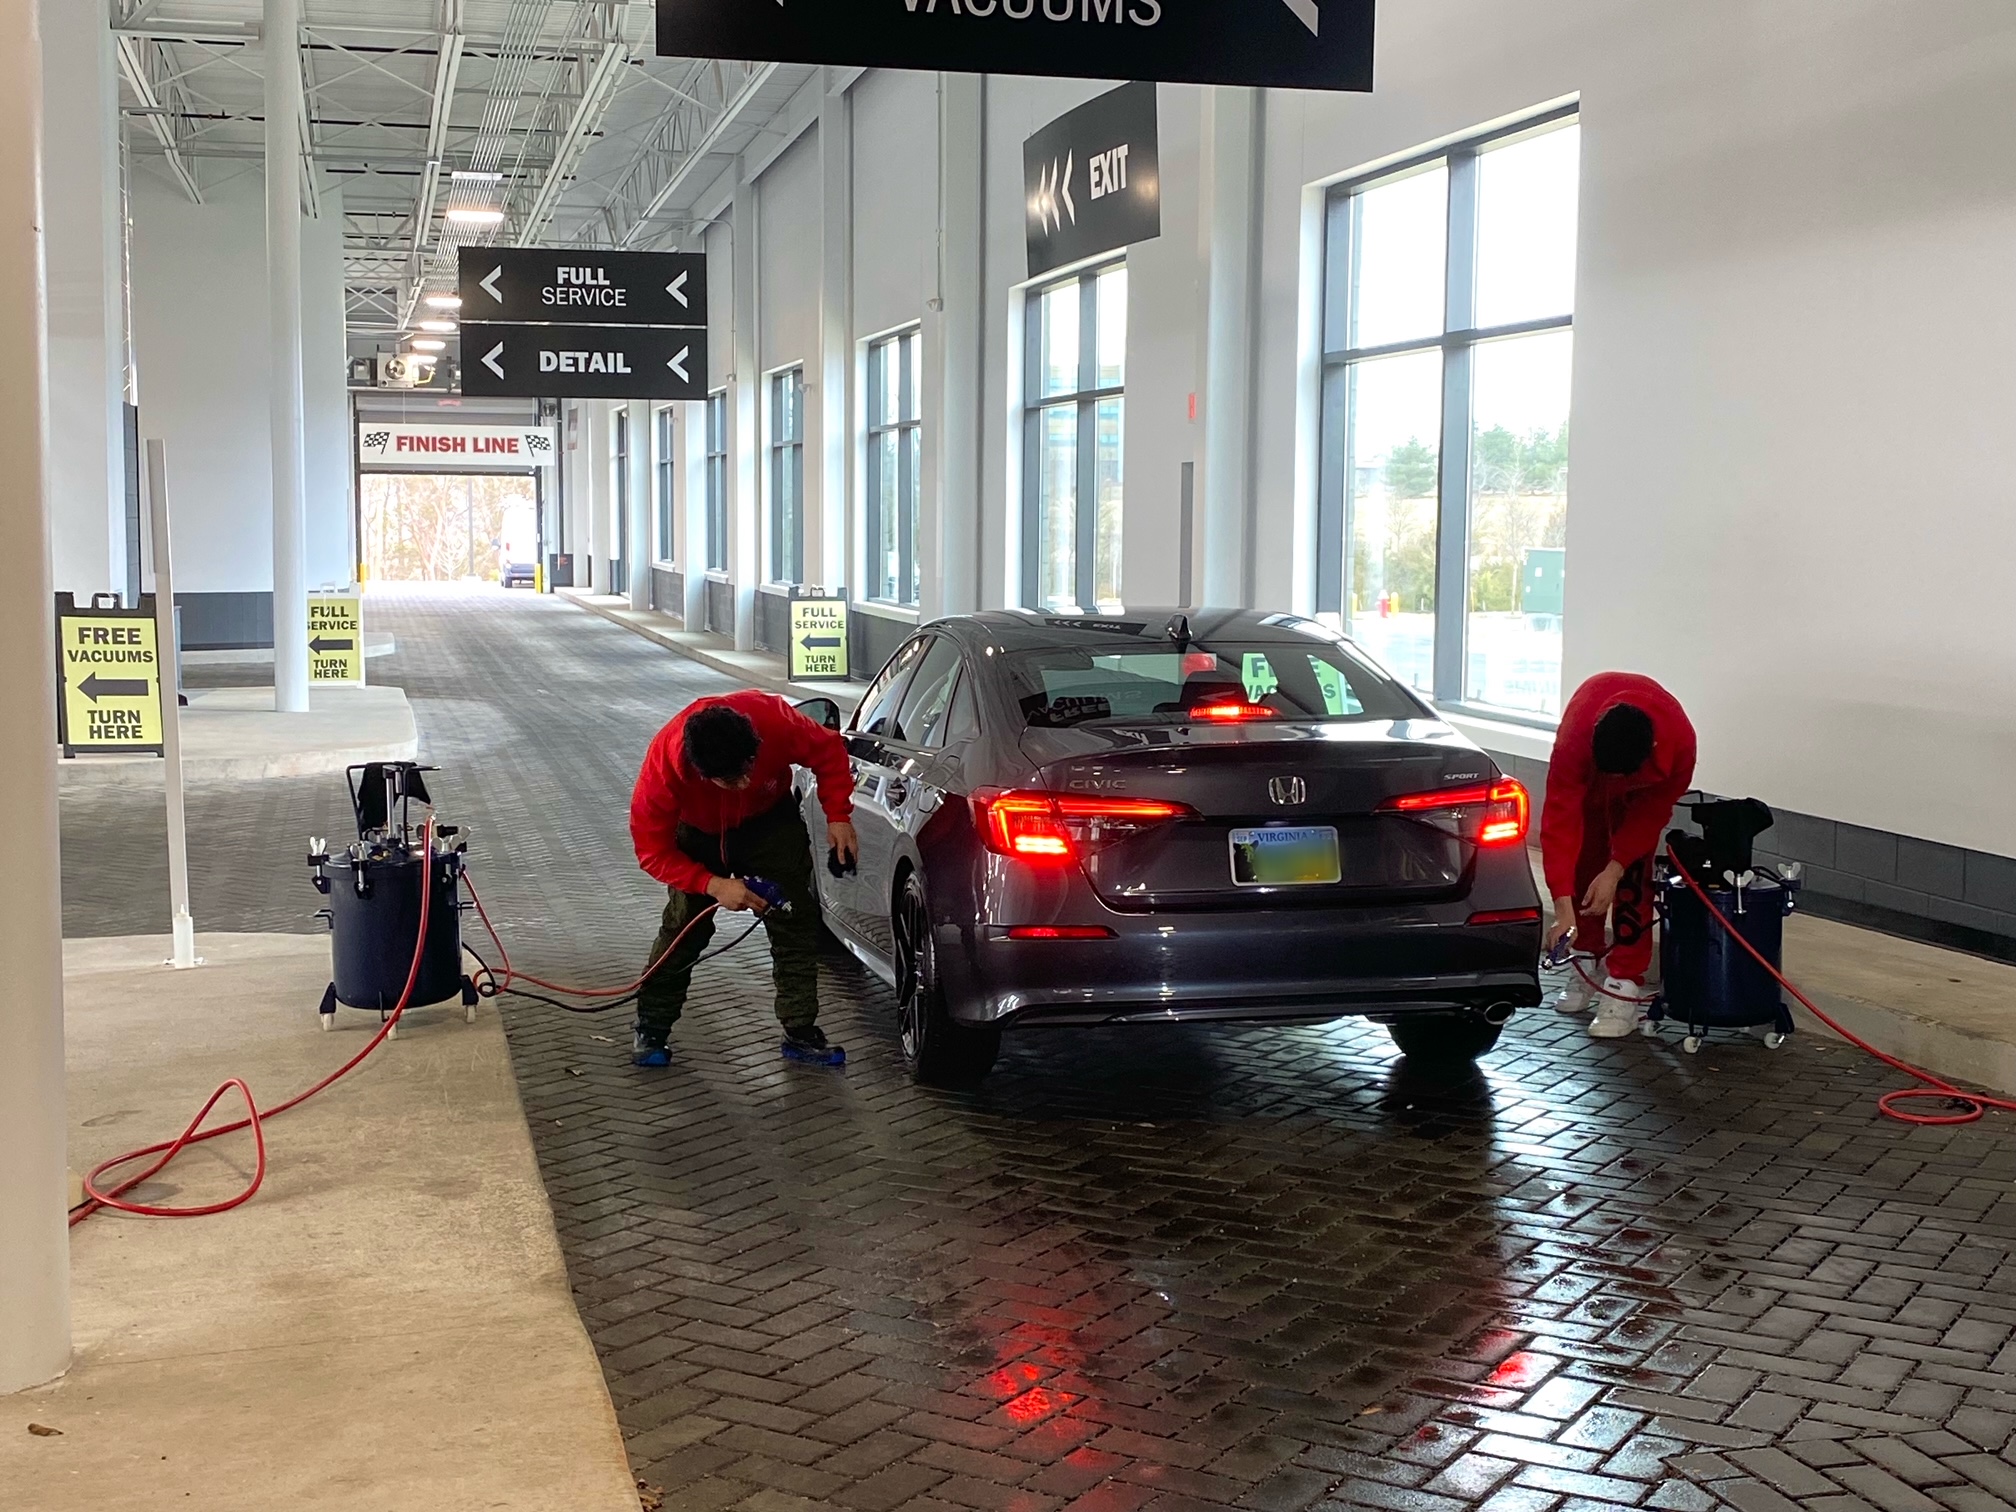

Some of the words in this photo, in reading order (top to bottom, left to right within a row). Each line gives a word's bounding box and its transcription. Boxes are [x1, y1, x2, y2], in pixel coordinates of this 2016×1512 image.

[1089, 144, 1129, 200] EXIT
[557, 266, 610, 286] FULL
[541, 286, 627, 307] SERVICE
[539, 351, 632, 374] DETAIL
[396, 435, 466, 453] FINISH
[473, 437, 520, 454] LINE
[311, 606, 350, 618] FULL
[802, 607, 837, 617] FULL
[794, 620, 845, 629] SERVICE
[77, 627, 142, 645] FREE
[67, 650, 154, 663] VACUUMS
[805, 655, 836, 664] TURN
[313, 659, 348, 669] TURN
[805, 664, 837, 673] HERE
[314, 669, 349, 679] HERE
[87, 710, 142, 724] TURN
[89, 725, 144, 739] HERE
[1443, 772, 1479, 780] SPORT
[1069, 779, 1127, 790] CIVIC
[1257, 831, 1308, 842] VIRGINIA
